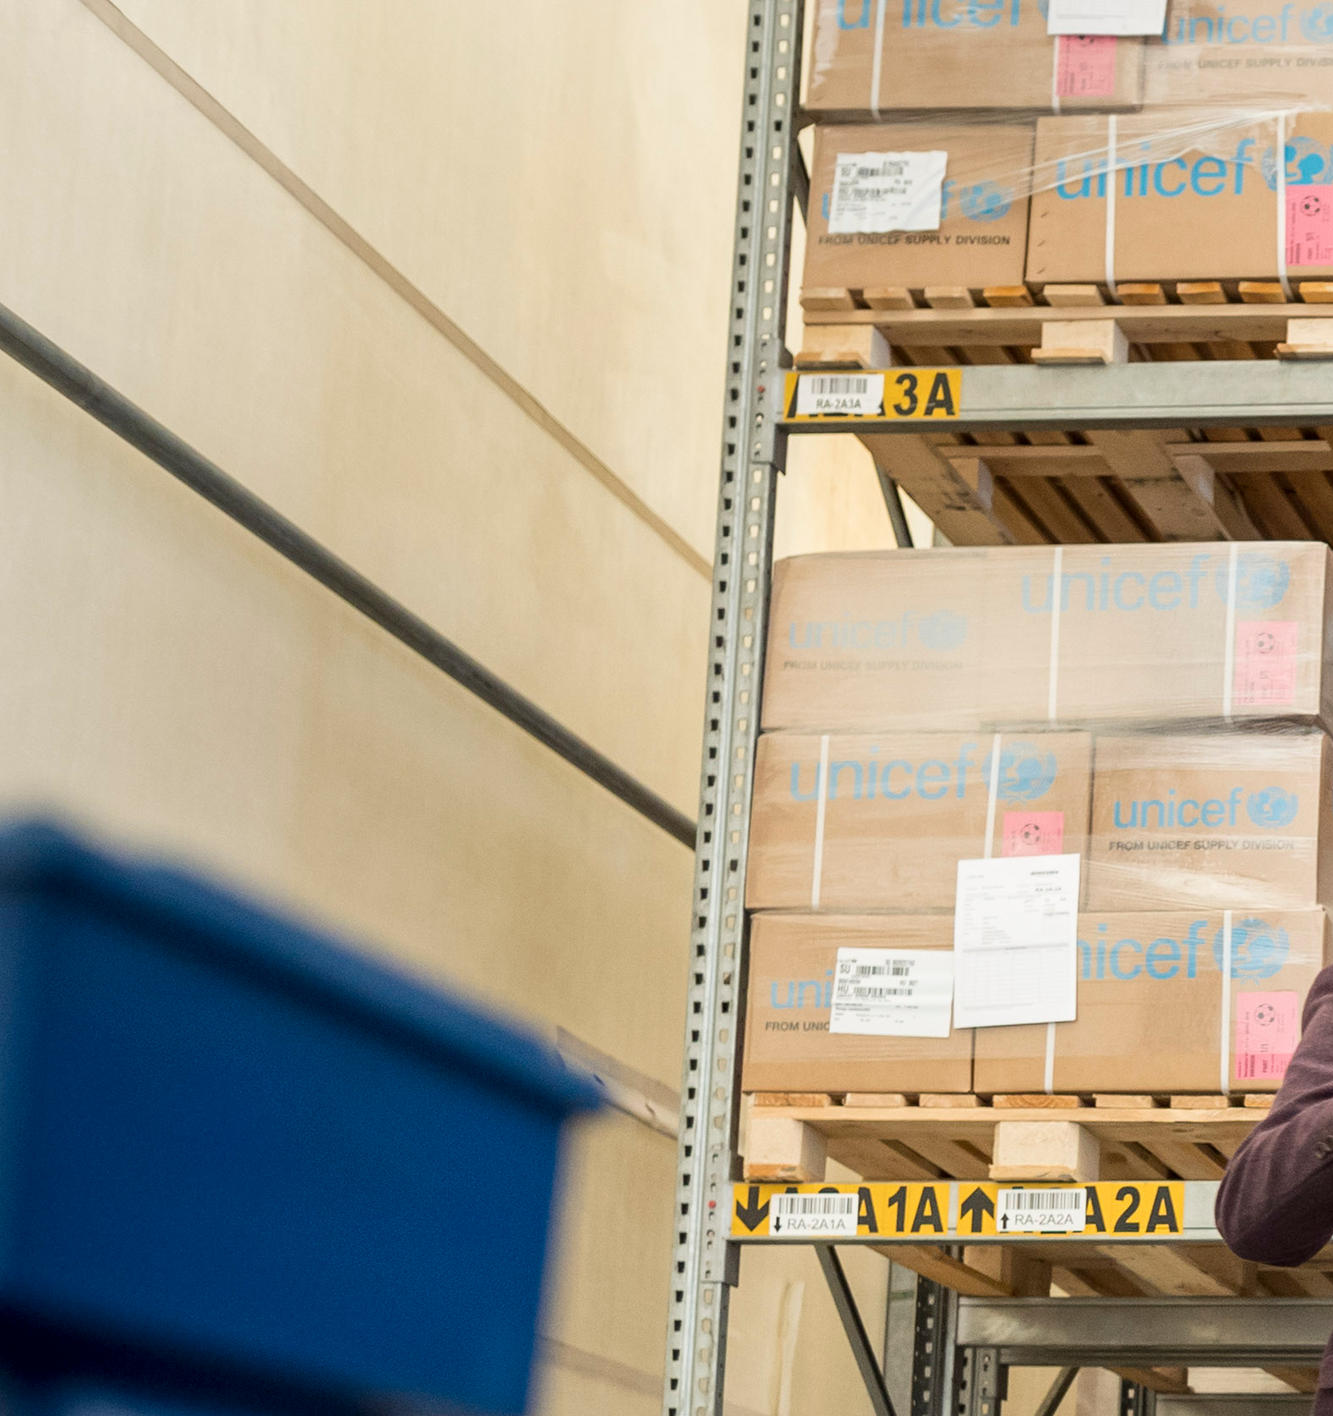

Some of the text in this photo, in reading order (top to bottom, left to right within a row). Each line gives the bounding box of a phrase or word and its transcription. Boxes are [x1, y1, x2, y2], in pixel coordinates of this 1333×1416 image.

[1245, 57, 1291, 68] SUPPLY
[1055, 138, 1257, 200] unicef
[858, 235, 900, 246] UNICEF
[903, 235, 952, 246] SUPPLY
[955, 235, 1011, 246] DIVISION
[1021, 554, 1211, 614] unicef
[820, 660, 862, 671] UNICEF
[789, 741, 976, 802] unicef
[1112, 786, 1243, 829] unicef
[1108, 838, 1295, 852] FROM UNICEF SUPPLY DIVISION
[765, 1021, 800, 1032] FROM
[786, 1217, 847, 1231] RA-2A1A
[1014, 1213, 1074, 1226] RA-2A2A
